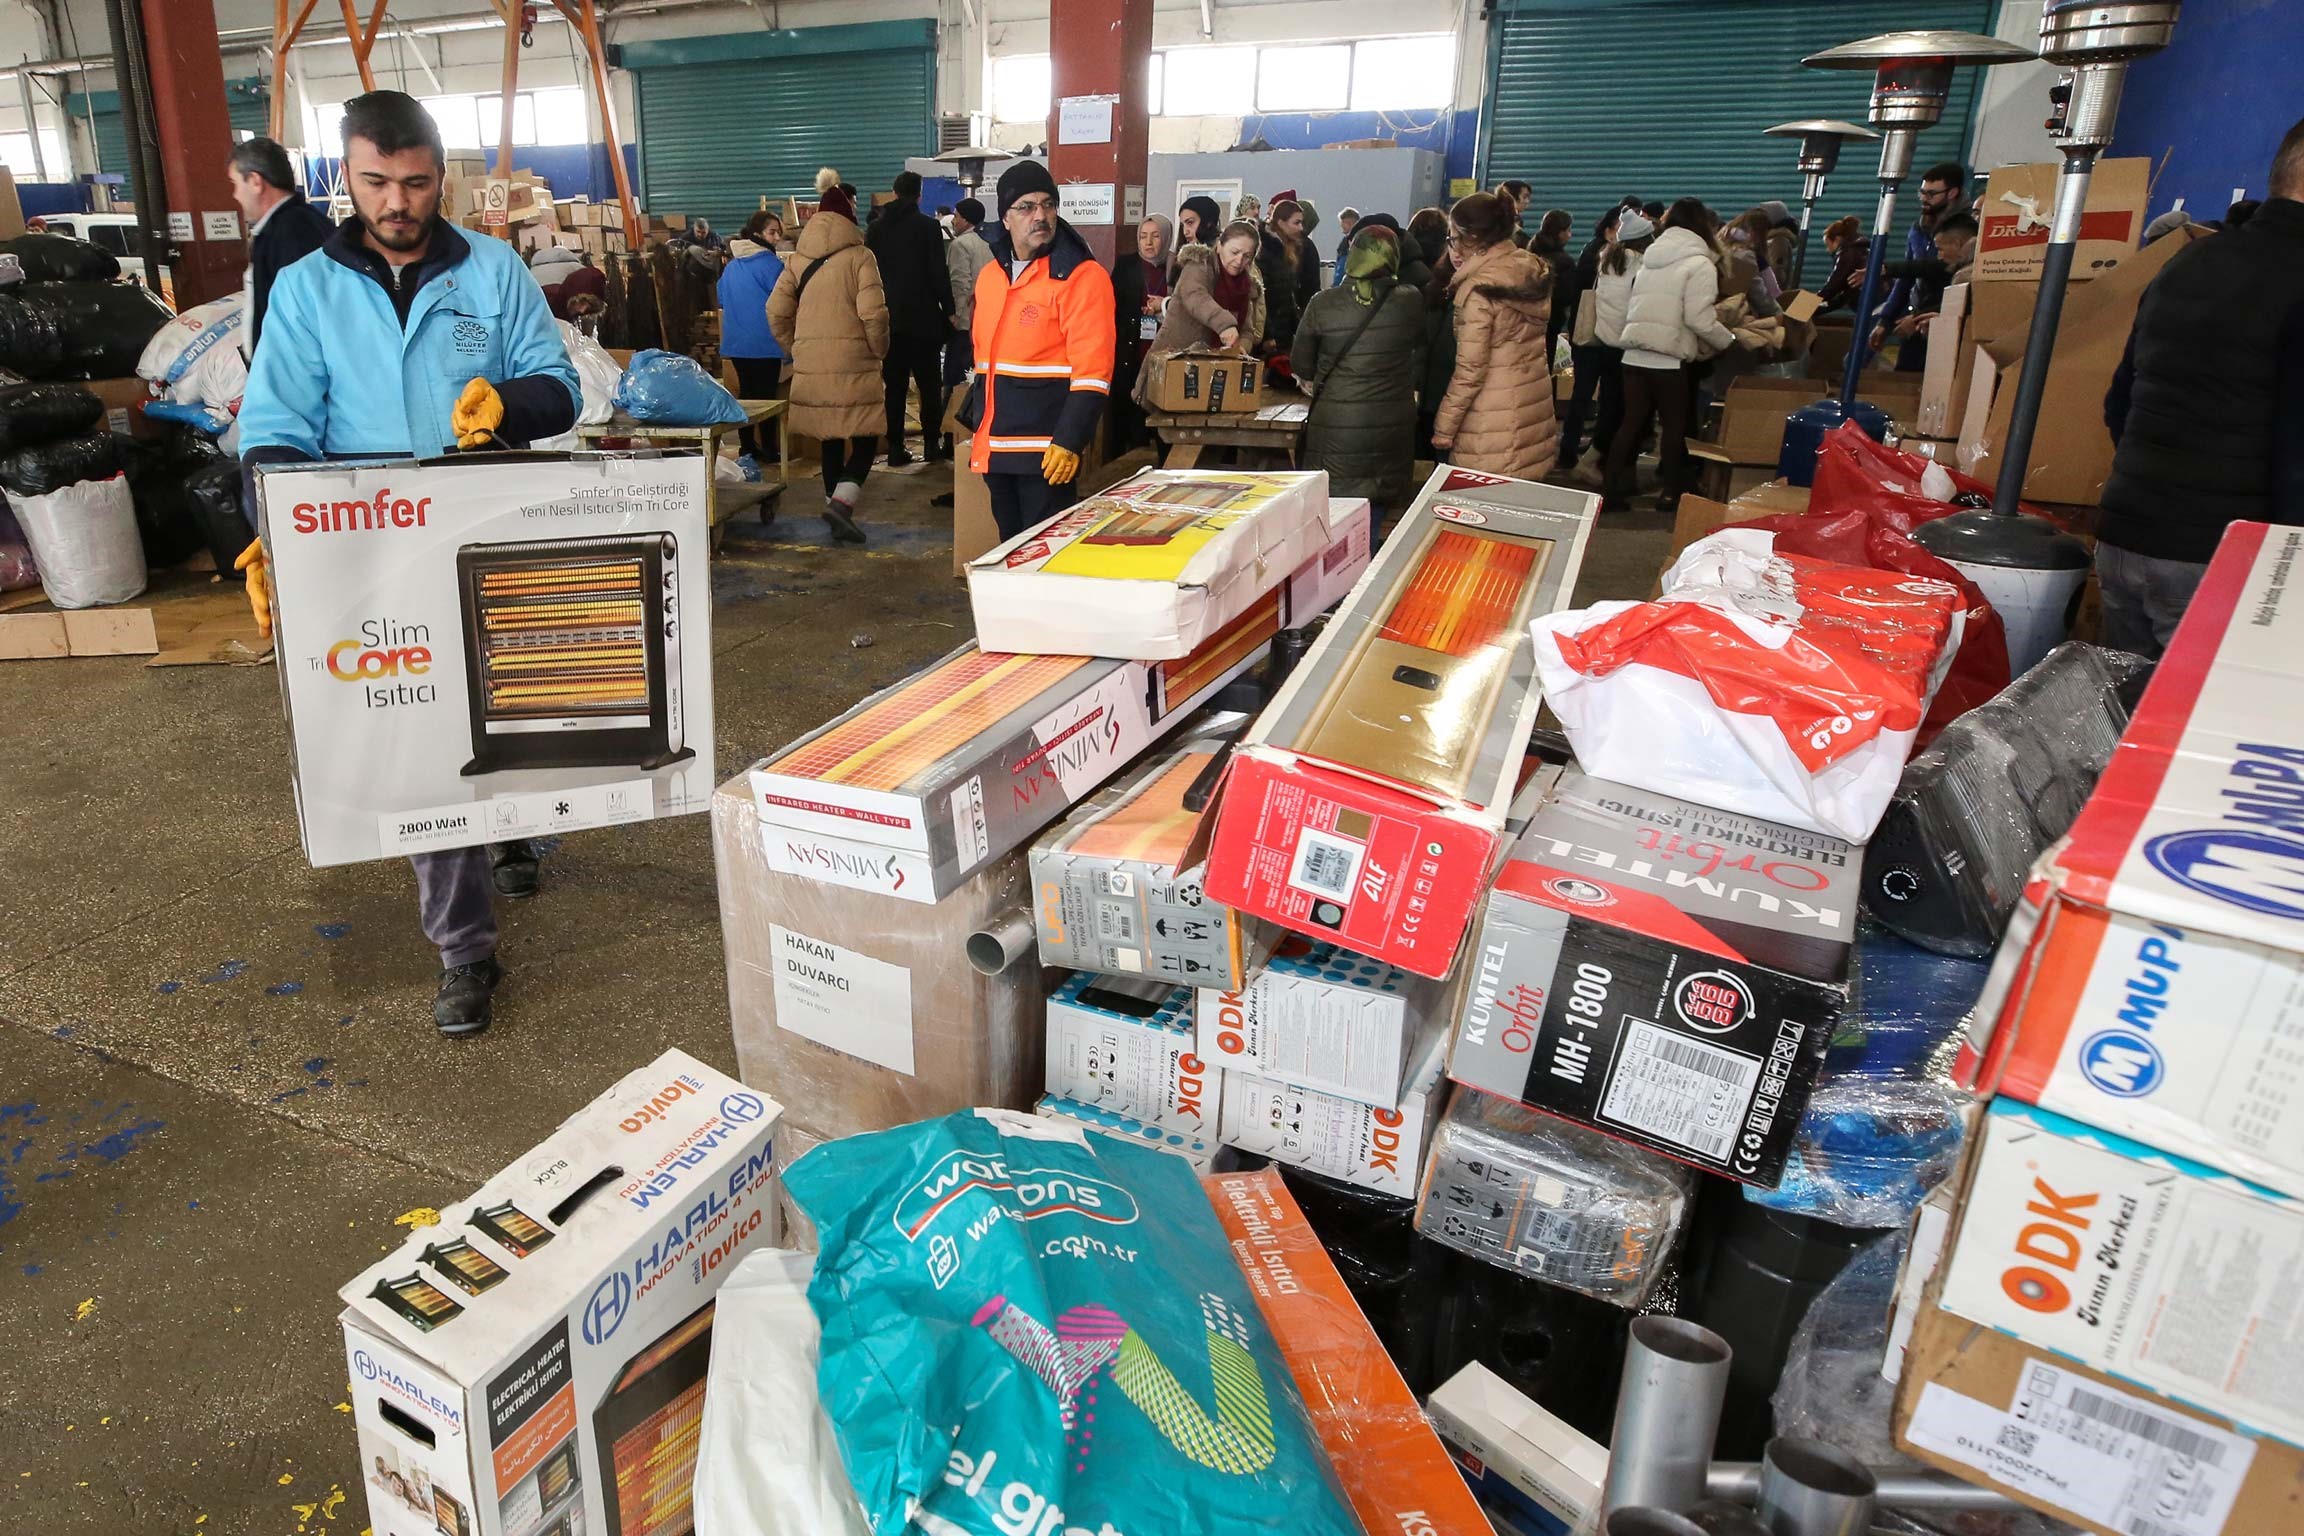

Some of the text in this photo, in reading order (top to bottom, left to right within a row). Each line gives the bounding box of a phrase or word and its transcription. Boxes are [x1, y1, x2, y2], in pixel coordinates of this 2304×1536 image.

[1062, 199, 1109, 208] GERİ DÖNÜŞÜM
[1073, 208, 1099, 216] KUTUSU
[570, 482, 690, 500] Simfer'in Geliştirdiği
[1453, 472, 1505, 485] ALF
[292, 488, 431, 534] simfer
[520, 504, 548, 519] Yeni
[549, 501, 581, 517] Nesil
[582, 500, 615, 516] Isıtıcı
[617, 499, 643, 514] Slim
[663, 497, 690, 512] Core
[307, 639, 432, 682] Tri Core
[361, 617, 430, 649] Slim
[366, 683, 436, 709] Isıtıcı
[398, 814, 468, 836] 2800 Watt
[766, 796, 910, 828] INFRARED HEATER WALL TYPE
[1674, 805, 1838, 852] ELECTRIC HEATER
[787, 842, 879, 880] MİNİSAN
[1635, 826, 1830, 891] Orbit
[1685, 819, 1847, 867] ELEKTRİKLİ
[1359, 857, 1389, 903] ALF
[1534, 833, 1842, 928] KUMTEL
[1041, 882, 1066, 945] UFO
[785, 933, 836, 963] HAKAN
[787, 958, 850, 992] DUVARCI
[1247, 986, 1259, 1025] Merkezi
[1465, 940, 1508, 1047] KUMTEL
[1496, 983, 1544, 1054] Orbit
[1217, 991, 1246, 1055] ODK
[1550, 962, 1613, 1085] MH-1800
[618, 1074, 705, 1133] mini lavica
[1177, 1052, 1206, 1120] ODK
[629, 1122, 739, 1210] HARLEM
[655, 1116, 719, 1171] INNOVATION
[1373, 1107, 1404, 1175] ODK
[533, 1159, 569, 1185] BLACK
[618, 1176, 647, 1199] YOU
[636, 1138, 773, 1275] HARLEM
[636, 1166, 774, 1301] INNOVATION 4 YOU
[2092, 1191, 2140, 1270] Merkezi
[699, 1207, 763, 1279] lavica
[1221, 1178, 1300, 1297] Elektrikli Isıtıcı
[2001, 1175, 2100, 1315] ODK
[1231, 1235, 1273, 1301] Quartz Heater
[378, 1364, 460, 1423] HARLEM
[378, 1378, 432, 1413] INNOVATION
[492, 1337, 566, 1410] ELECTRICAL HEATER
[496, 1360, 563, 1427] ELEKTRİKLİ ISITICI
